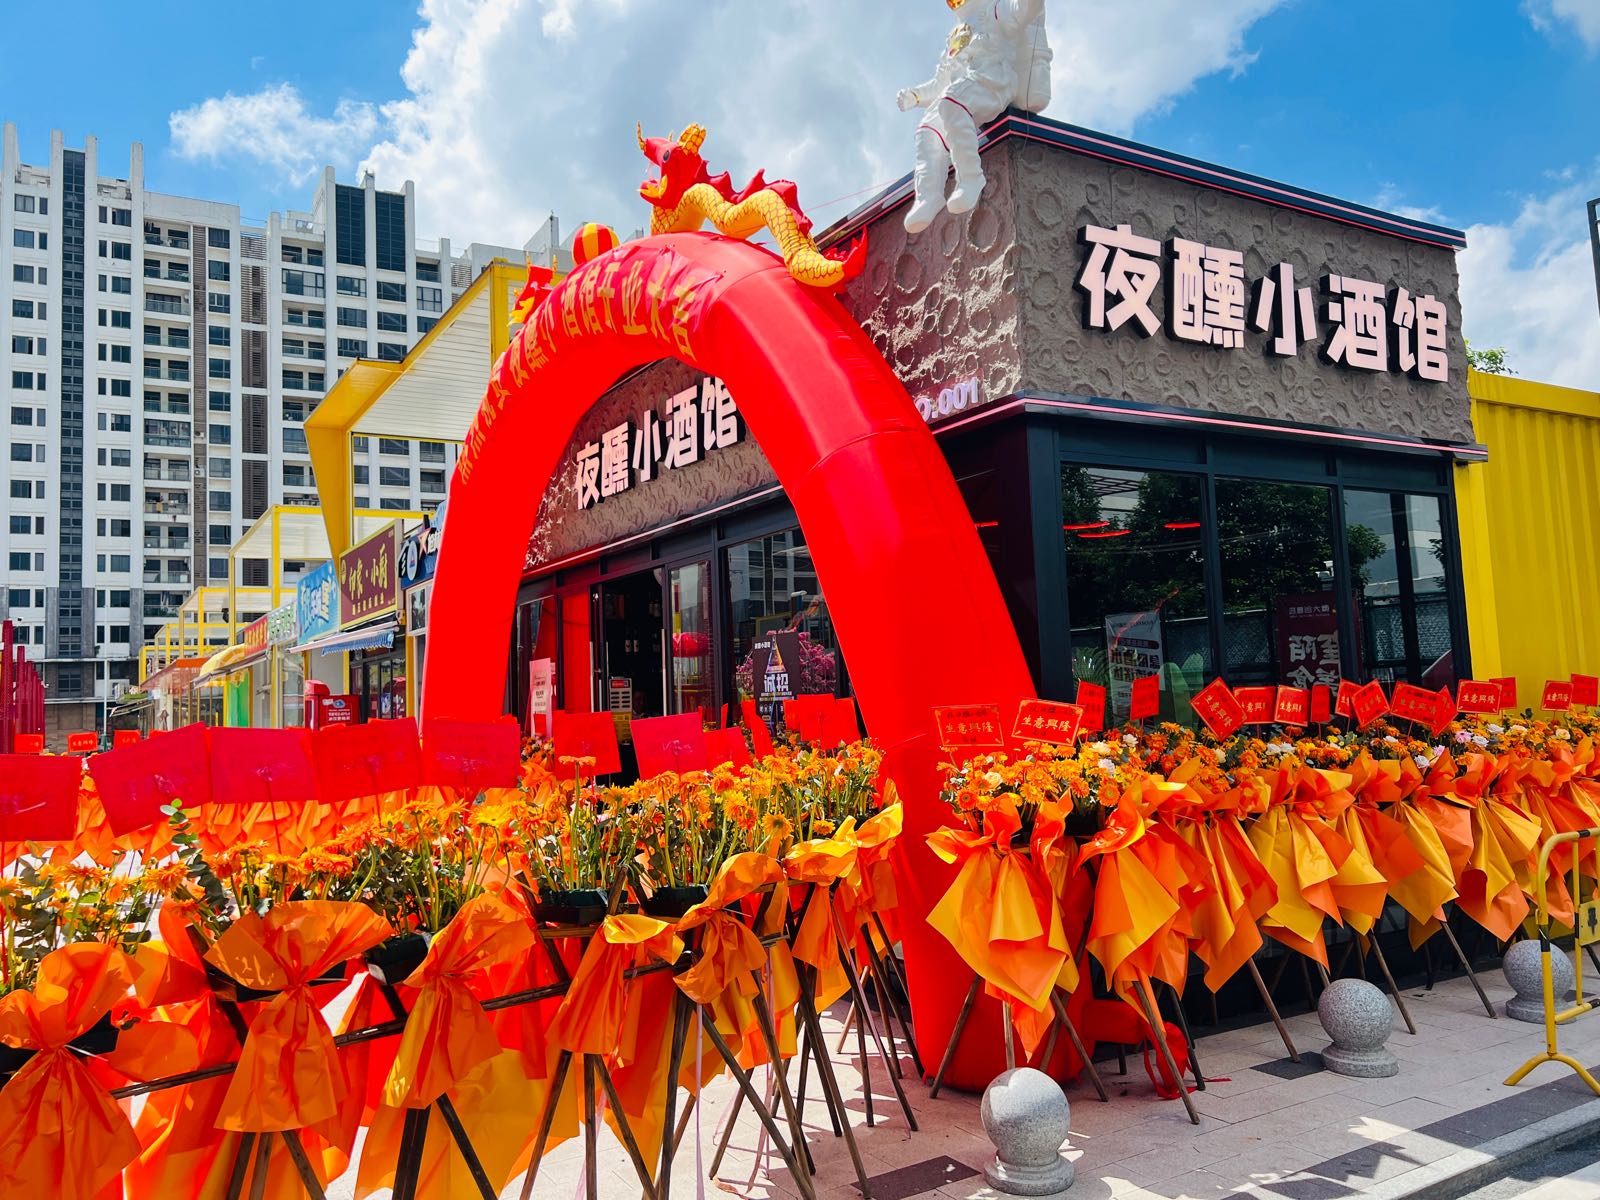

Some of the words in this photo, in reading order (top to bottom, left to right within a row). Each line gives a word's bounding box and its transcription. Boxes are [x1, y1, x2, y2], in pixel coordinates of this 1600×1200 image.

[1079, 223, 1449, 383] 夜醺小酒馆
[575, 376, 738, 510] 夜醺小酒馆
[764, 673, 789, 693] 诚招
[945, 721, 994, 734] 生意興隆
[1021, 714, 1072, 732] 生意興隆
